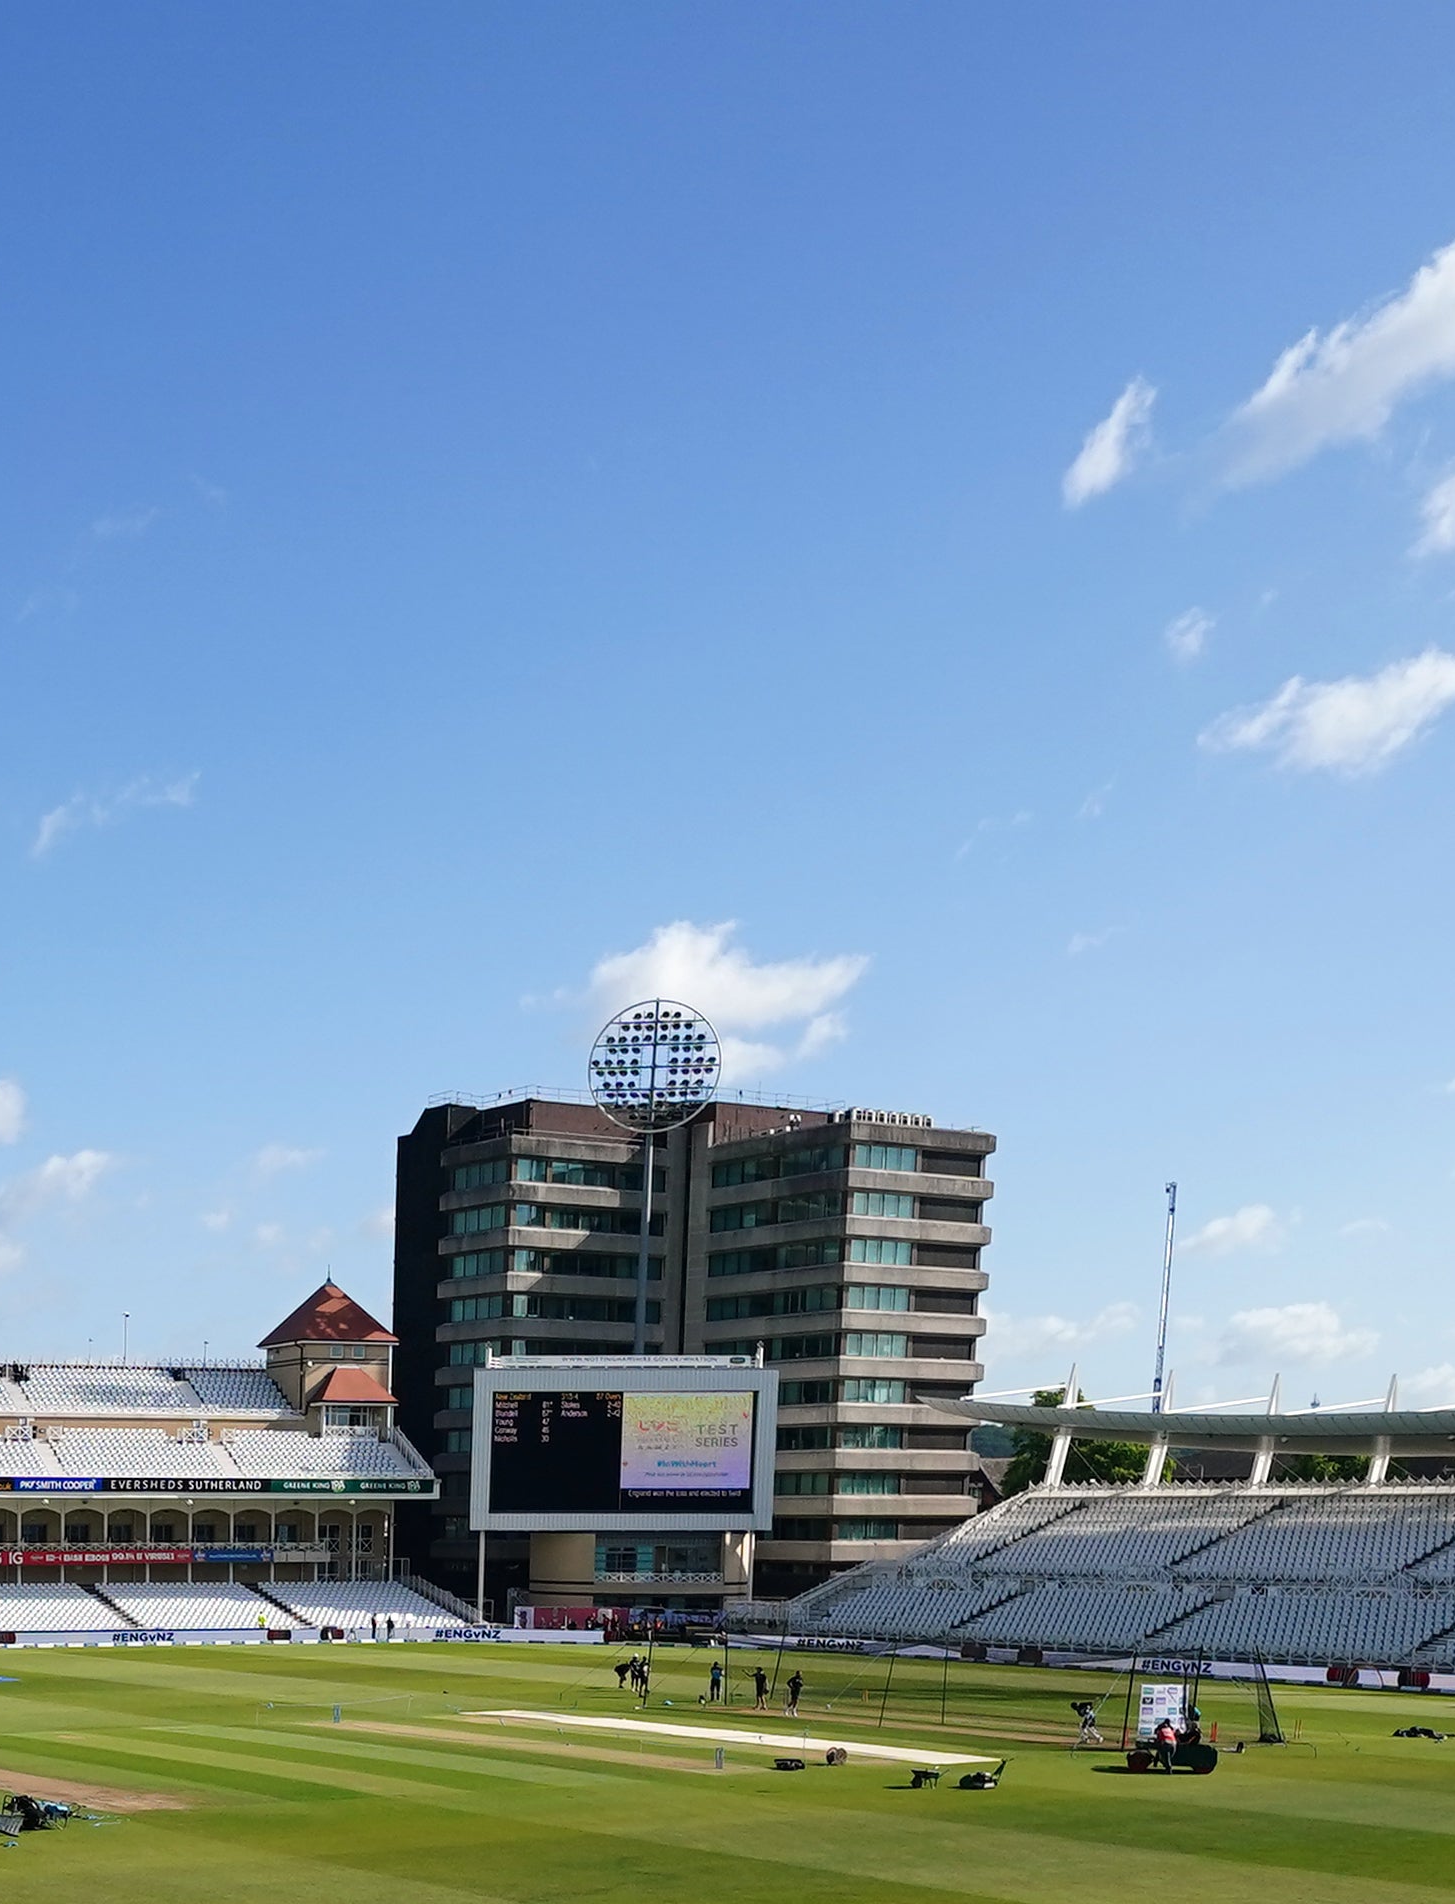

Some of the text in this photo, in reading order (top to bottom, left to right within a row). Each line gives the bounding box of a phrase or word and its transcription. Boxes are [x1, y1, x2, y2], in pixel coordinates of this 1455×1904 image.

[495, 1418, 514, 1426] Young
[494, 1427, 518, 1435] Conway
[697, 1424, 739, 1435] TEST
[695, 1437, 739, 1447] SERIES
[36, 1480, 62, 1490] SMITH
[62, 1480, 96, 1490] COOPER
[110, 1479, 262, 1490] EVERSHEDS SUTHERLAND
[283, 1481, 311, 1489] GREENE
[359, 1481, 387, 1489] GREENE
[9, 1552, 24, 1565] IG
[112, 1633, 175, 1643] #ENGvNZ
[435, 1629, 501, 1639] #ENGvNZ
[796, 1638, 865, 1650] #ENGvNZ
